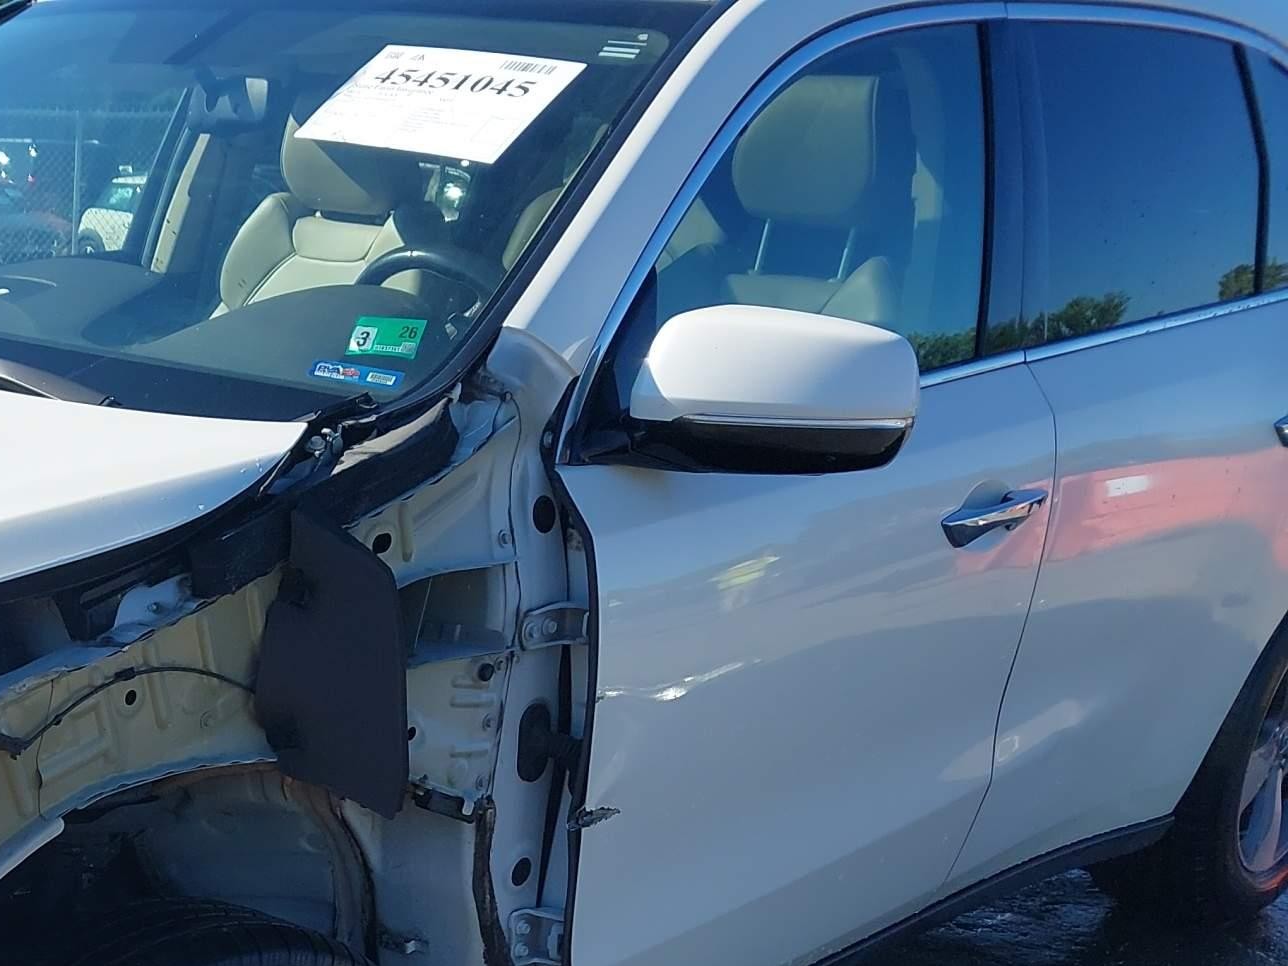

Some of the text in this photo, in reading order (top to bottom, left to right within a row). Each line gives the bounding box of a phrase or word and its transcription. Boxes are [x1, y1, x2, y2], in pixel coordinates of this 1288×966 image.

[374, 67, 537, 98] 45451045
[355, 330, 371, 348] 3
[399, 325, 419, 340] 26
